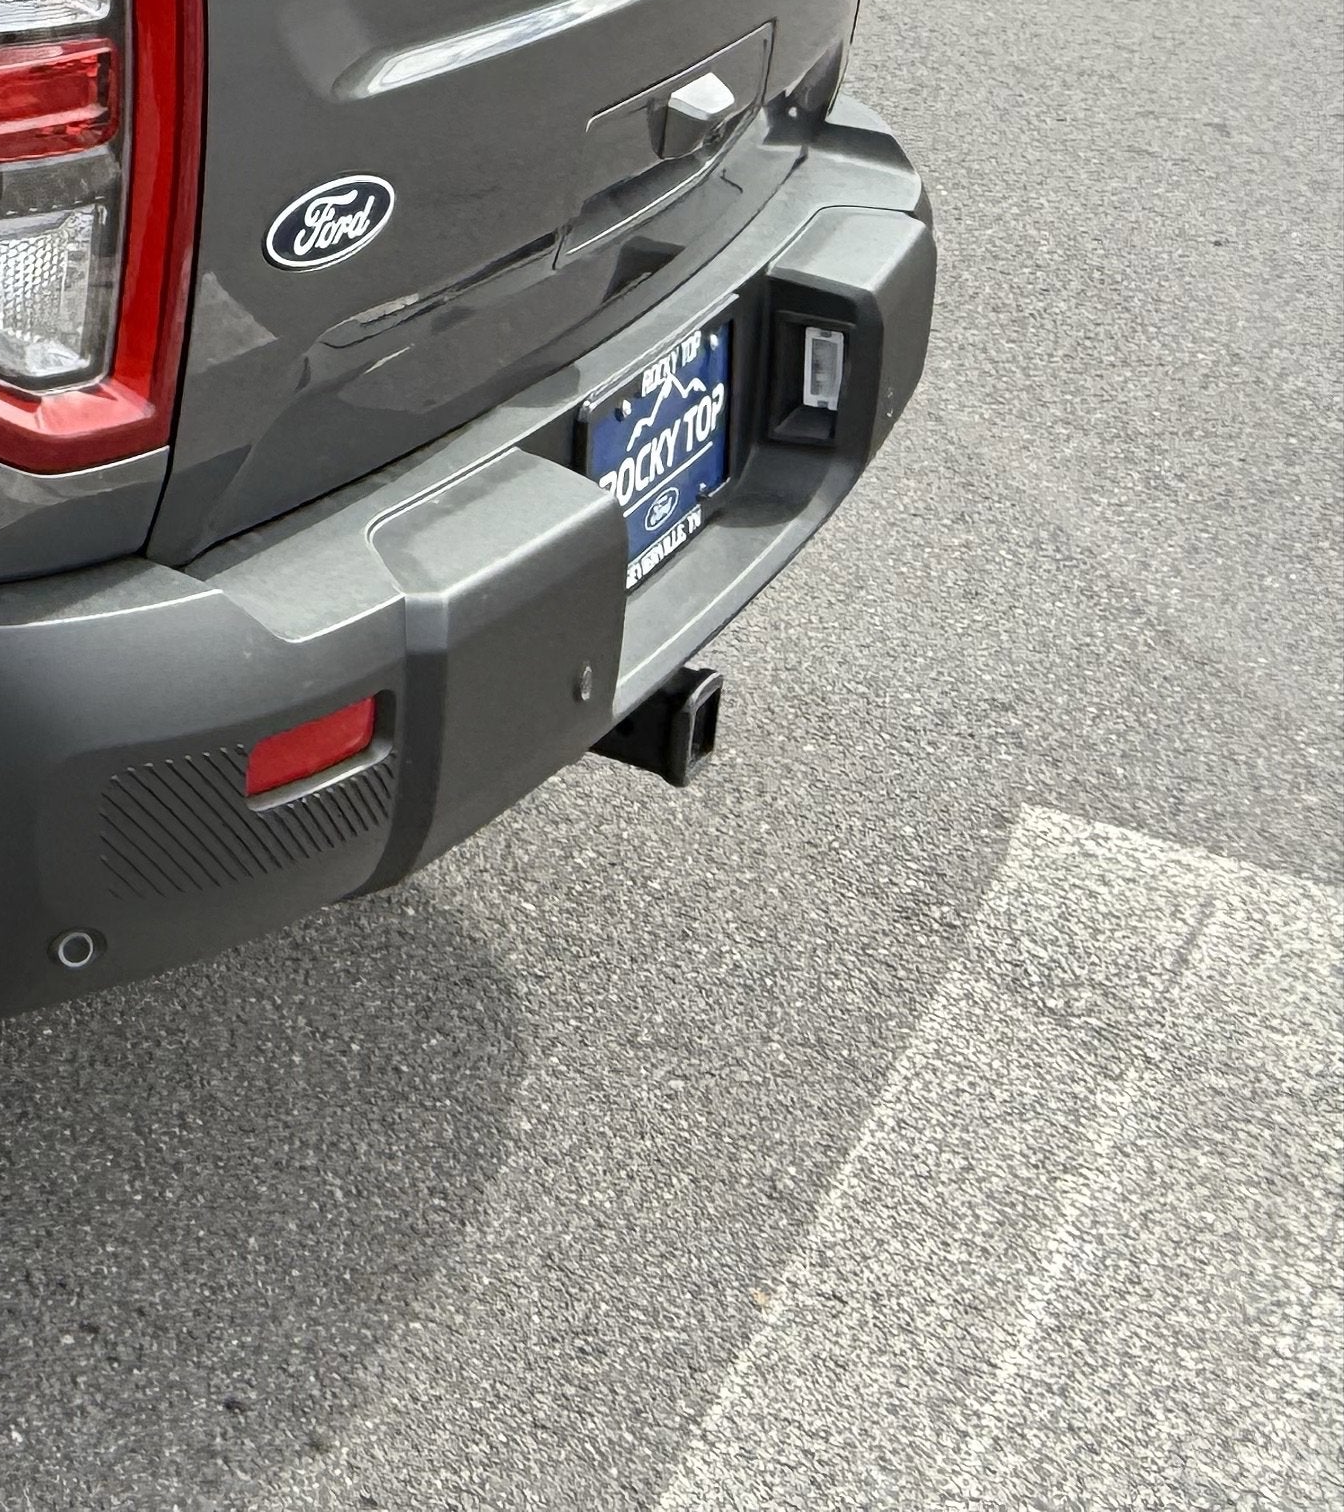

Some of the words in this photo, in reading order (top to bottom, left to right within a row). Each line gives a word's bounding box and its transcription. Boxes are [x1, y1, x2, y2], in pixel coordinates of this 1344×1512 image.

[292, 188, 376, 256] Ford
[681, 330, 702, 367] TOP
[682, 383, 725, 453] TOP
